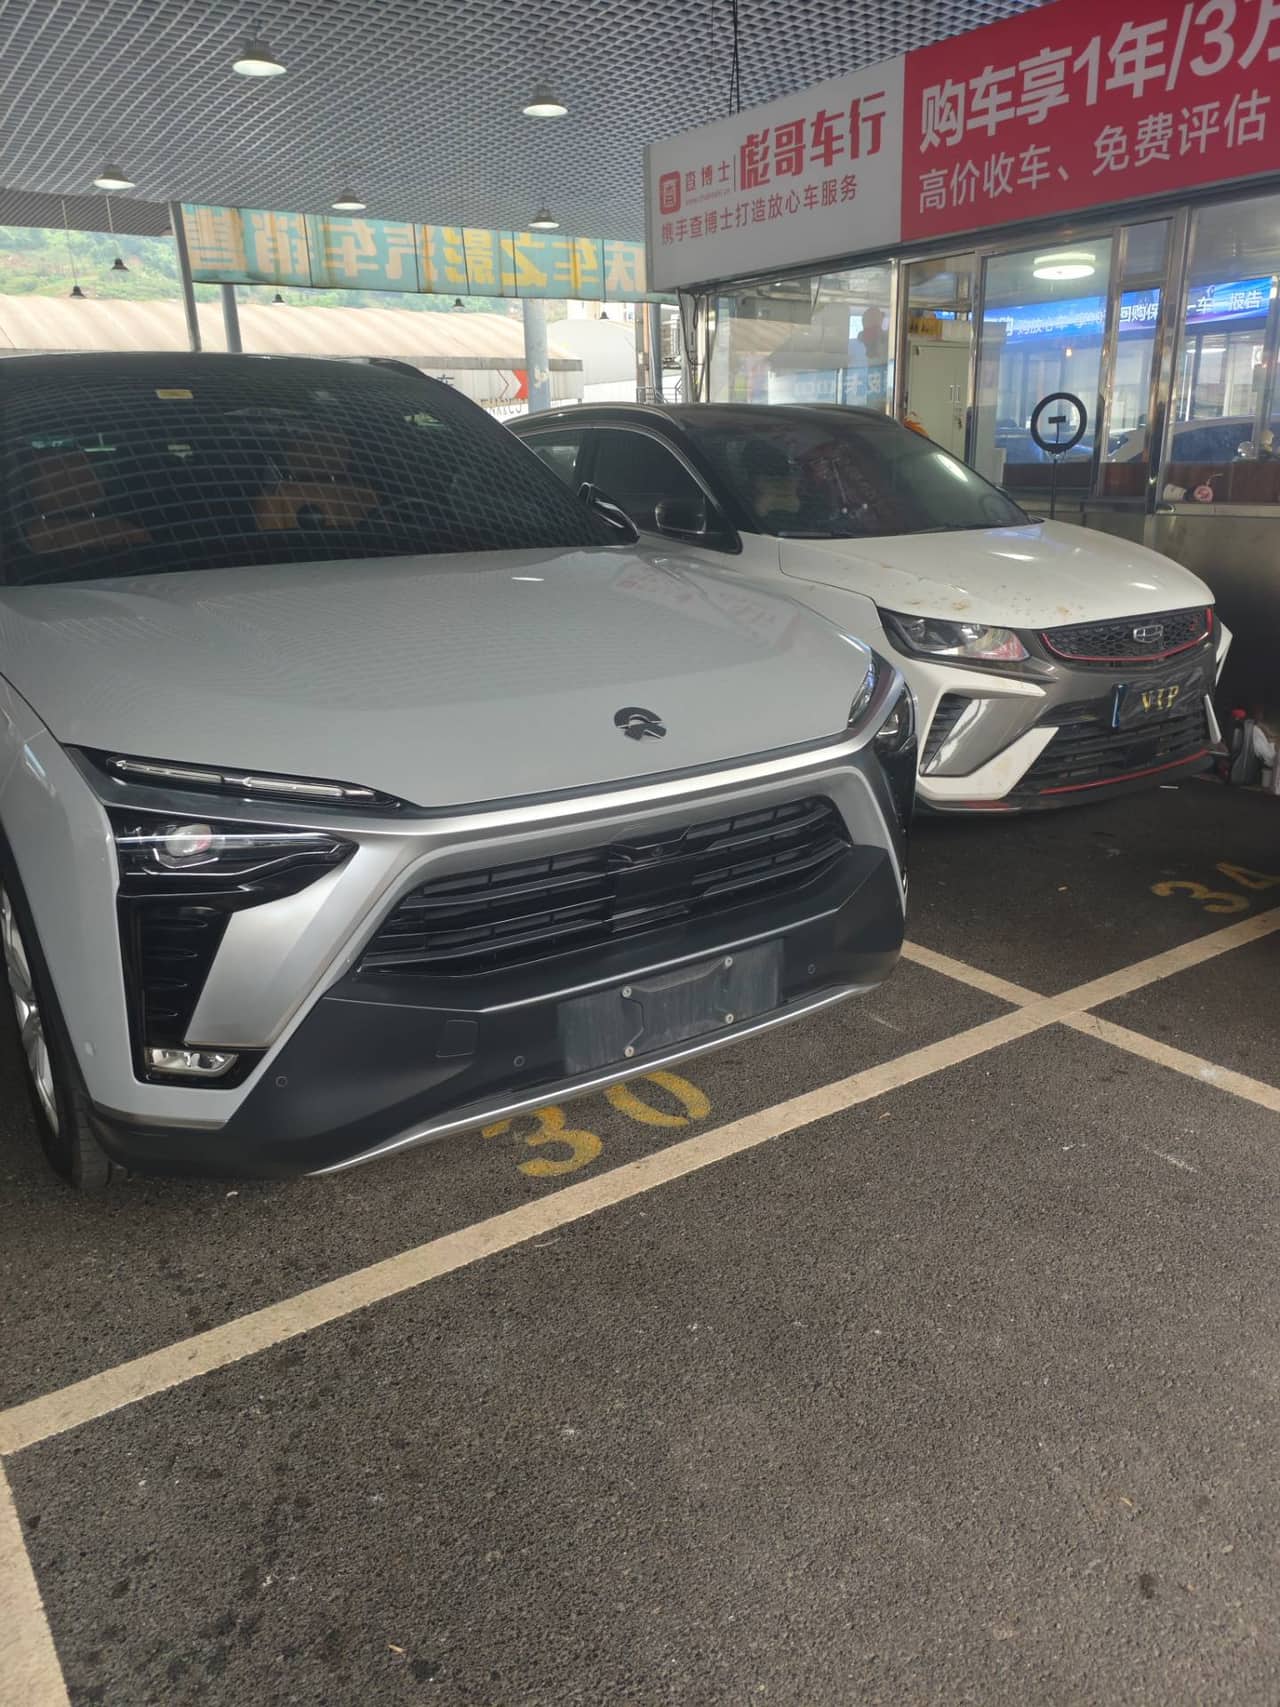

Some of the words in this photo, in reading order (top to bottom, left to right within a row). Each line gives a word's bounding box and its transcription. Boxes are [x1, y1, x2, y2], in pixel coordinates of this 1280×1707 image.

[740, 91, 886, 191] 彪哥车行
[919, 88, 1271, 214] 高价收车、免费评估
[1141, 685, 1179, 712] VIP
[482, 1070, 712, 1177] 30
